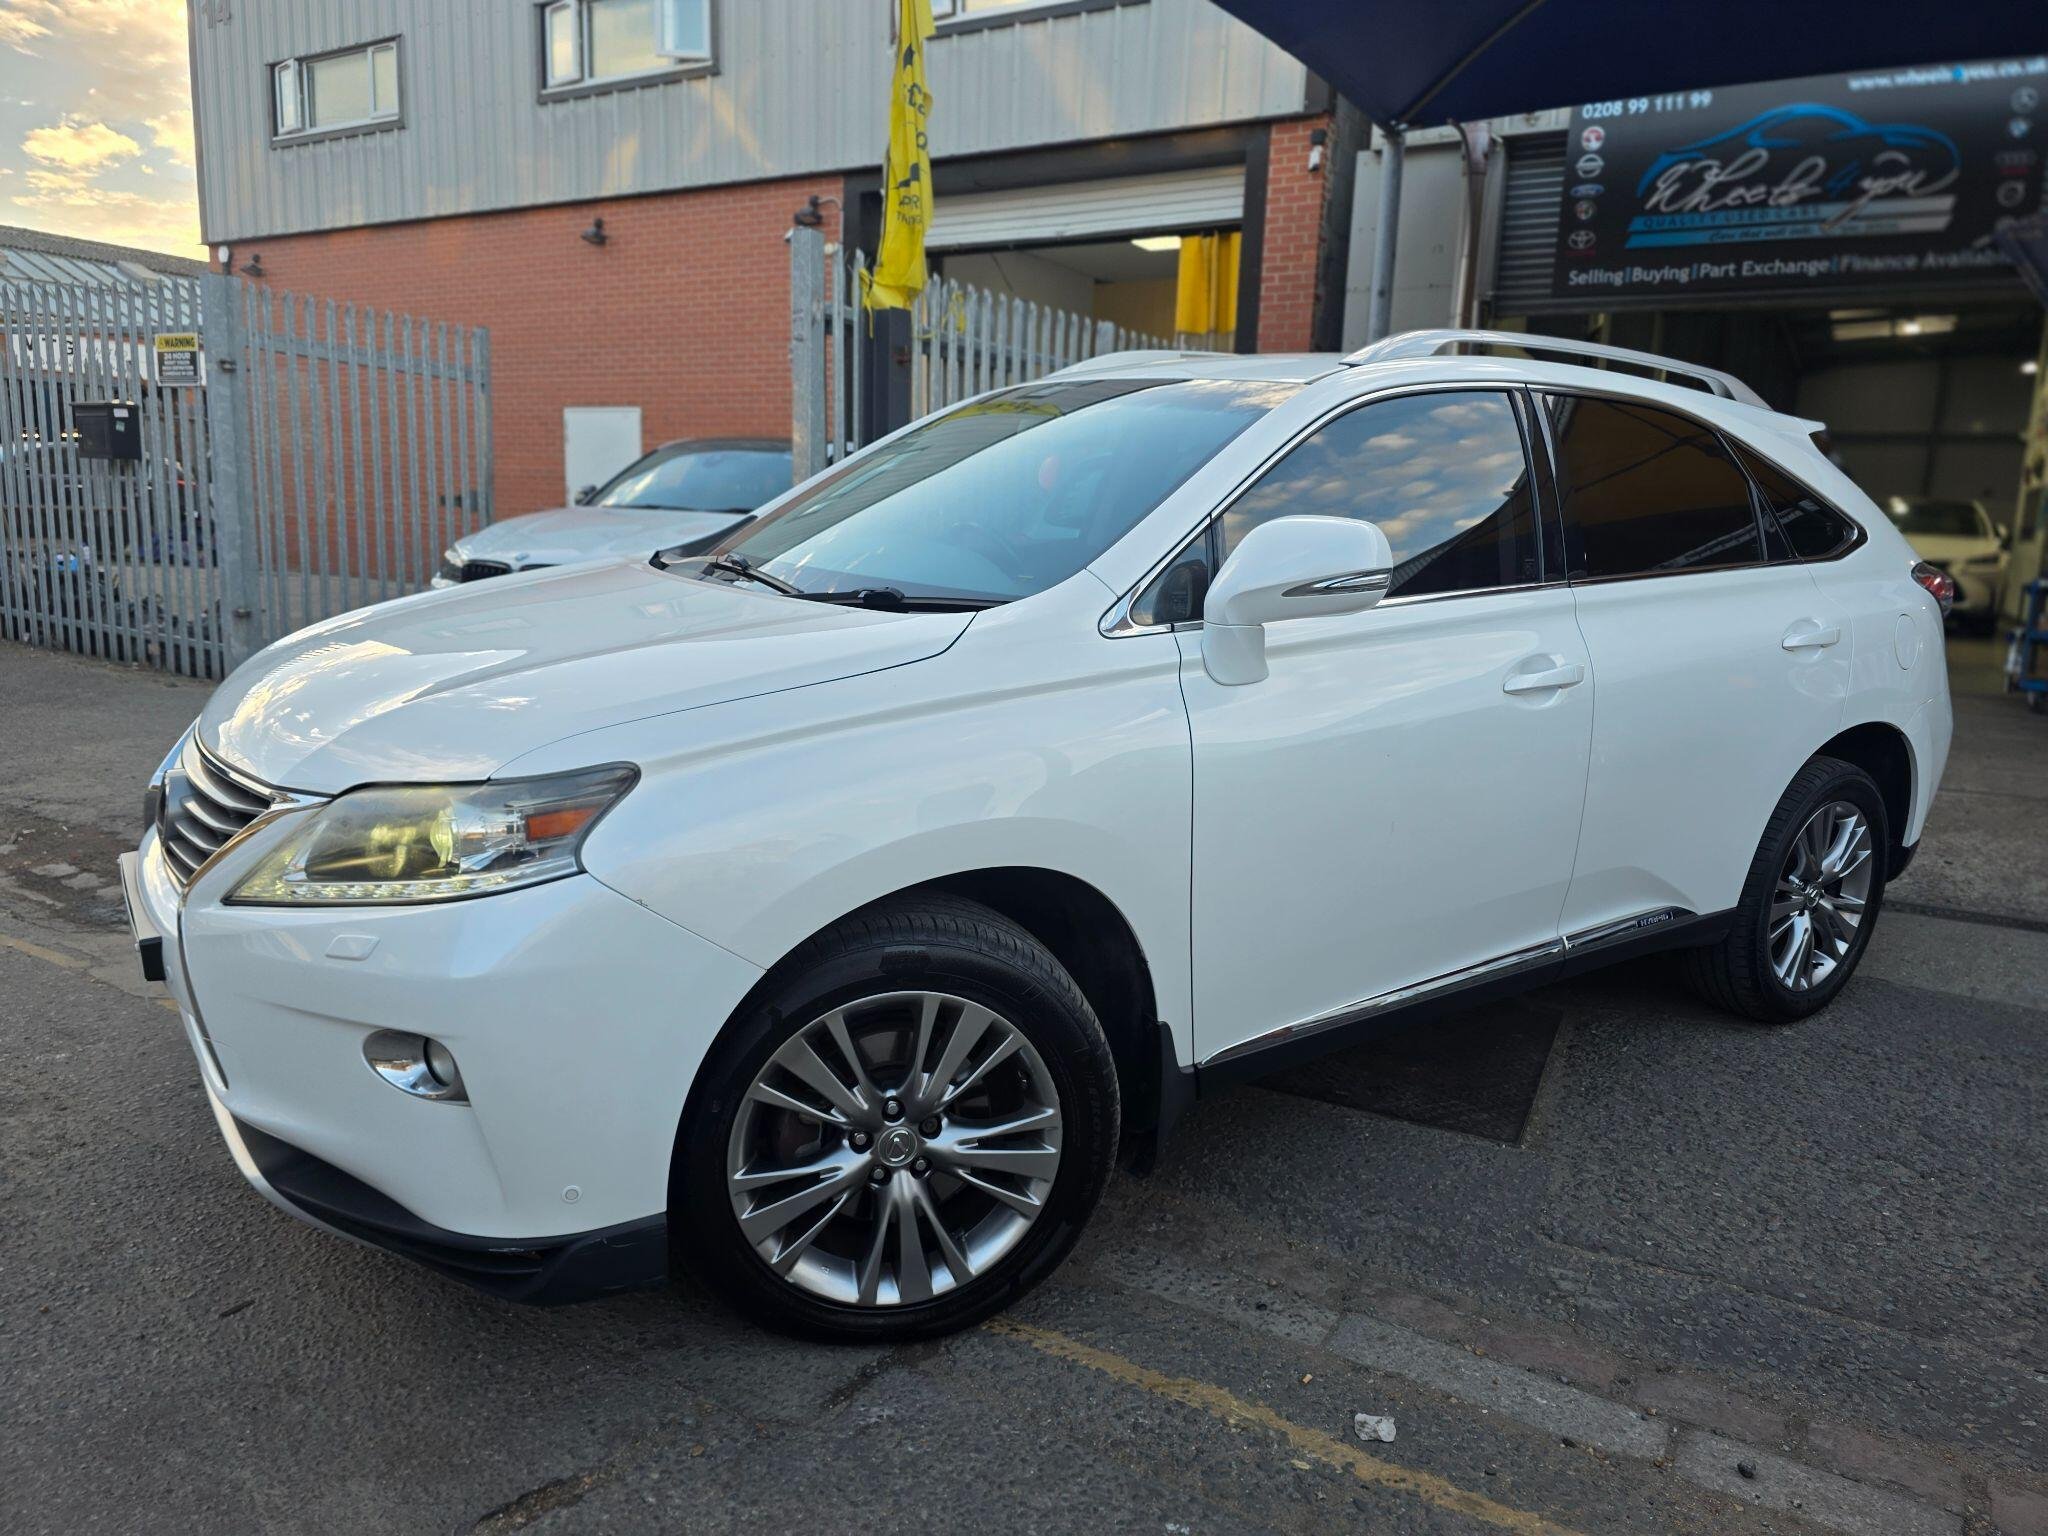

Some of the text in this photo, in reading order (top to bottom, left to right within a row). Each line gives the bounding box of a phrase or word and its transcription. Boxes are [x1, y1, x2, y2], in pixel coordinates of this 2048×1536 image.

[1582, 90, 1713, 119] 0208 99 111 99
[1642, 212, 1719, 229] QUALITY
[1568, 268, 1624, 287] Selling
[1632, 265, 1690, 284] Buying
[1700, 262, 1736, 278] Part
[1741, 257, 1831, 277] Exchange
[1839, 254, 1919, 273] Finance
[164, 336, 196, 348] WARNING
[173, 351, 191, 360] HOUR
